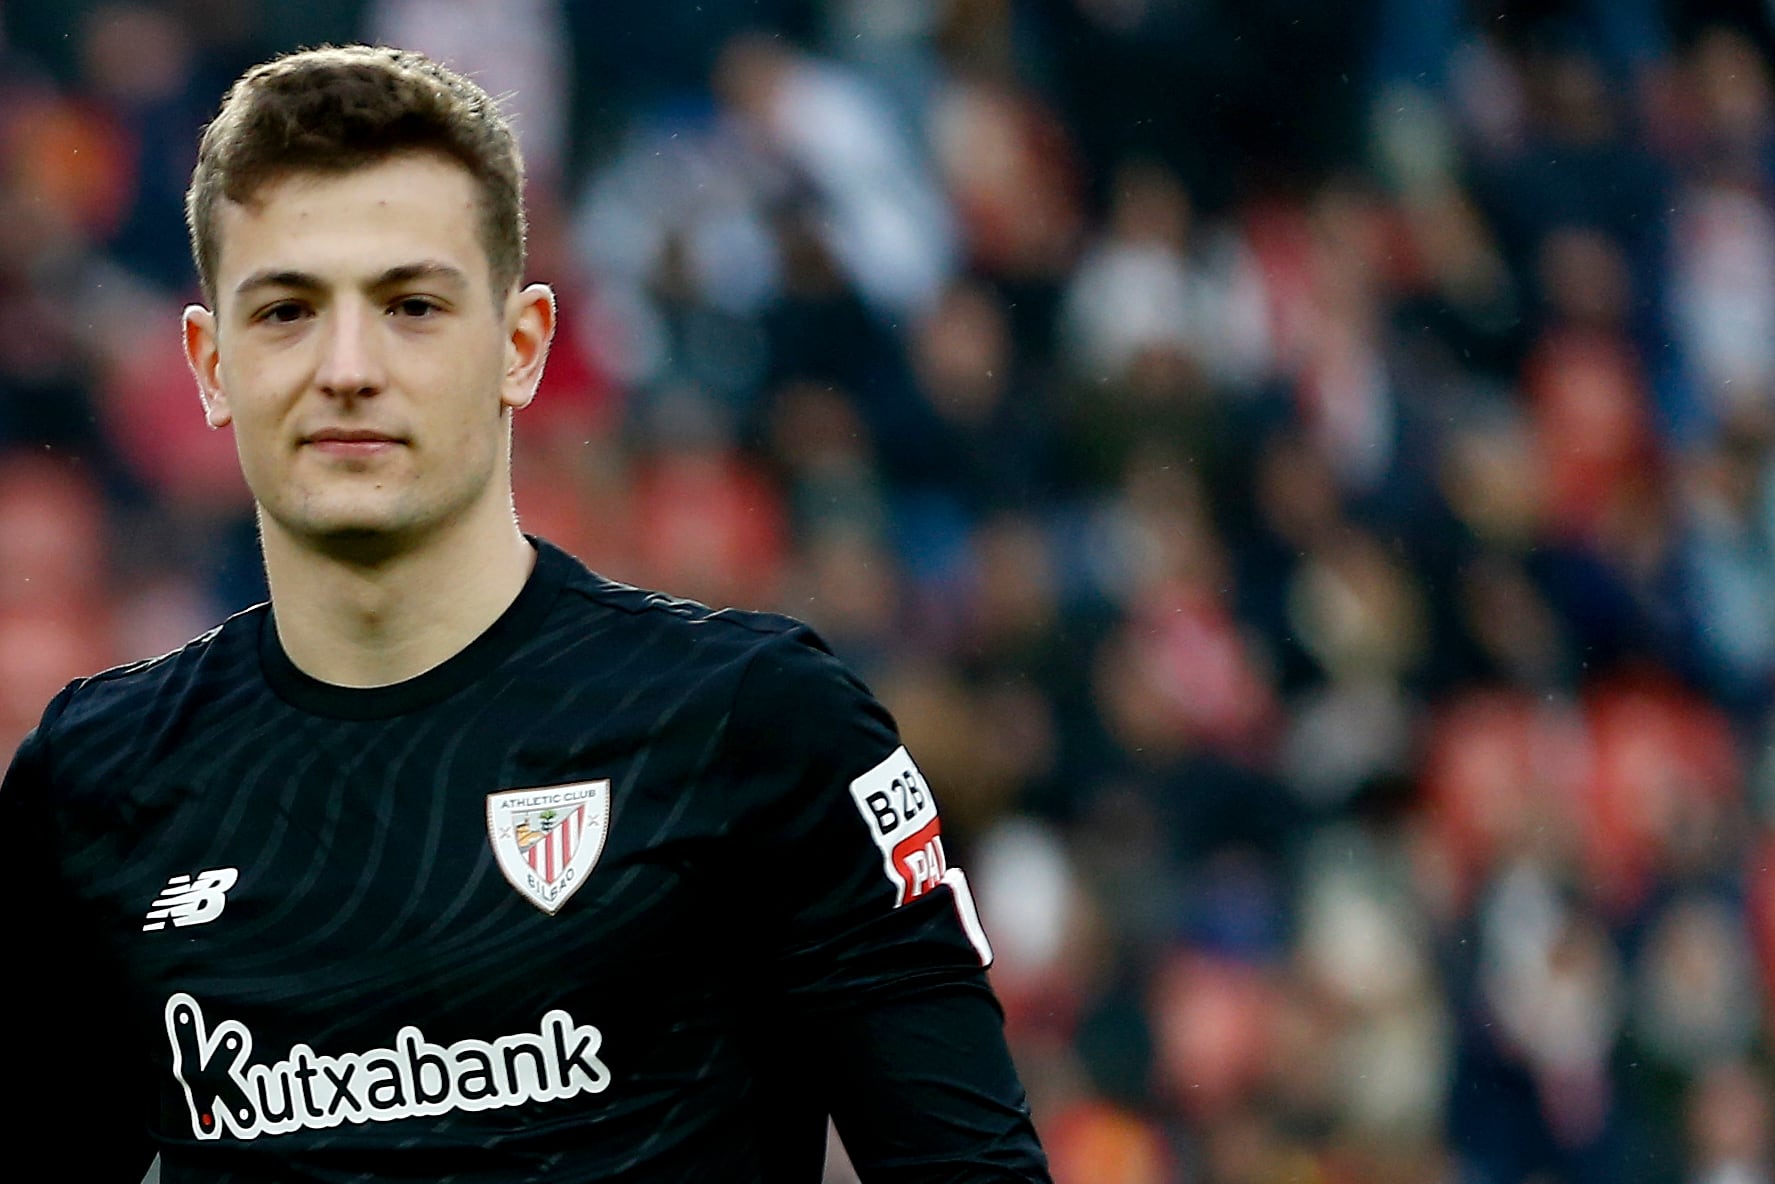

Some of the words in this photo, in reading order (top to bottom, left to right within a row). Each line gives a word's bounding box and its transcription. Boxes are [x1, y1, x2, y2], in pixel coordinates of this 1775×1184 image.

[501, 794, 562, 809] ATHLETIC
[563, 789, 597, 801] CLUB
[527, 868, 575, 902] BILBAO
[165, 993, 611, 1140] Kutxabank
